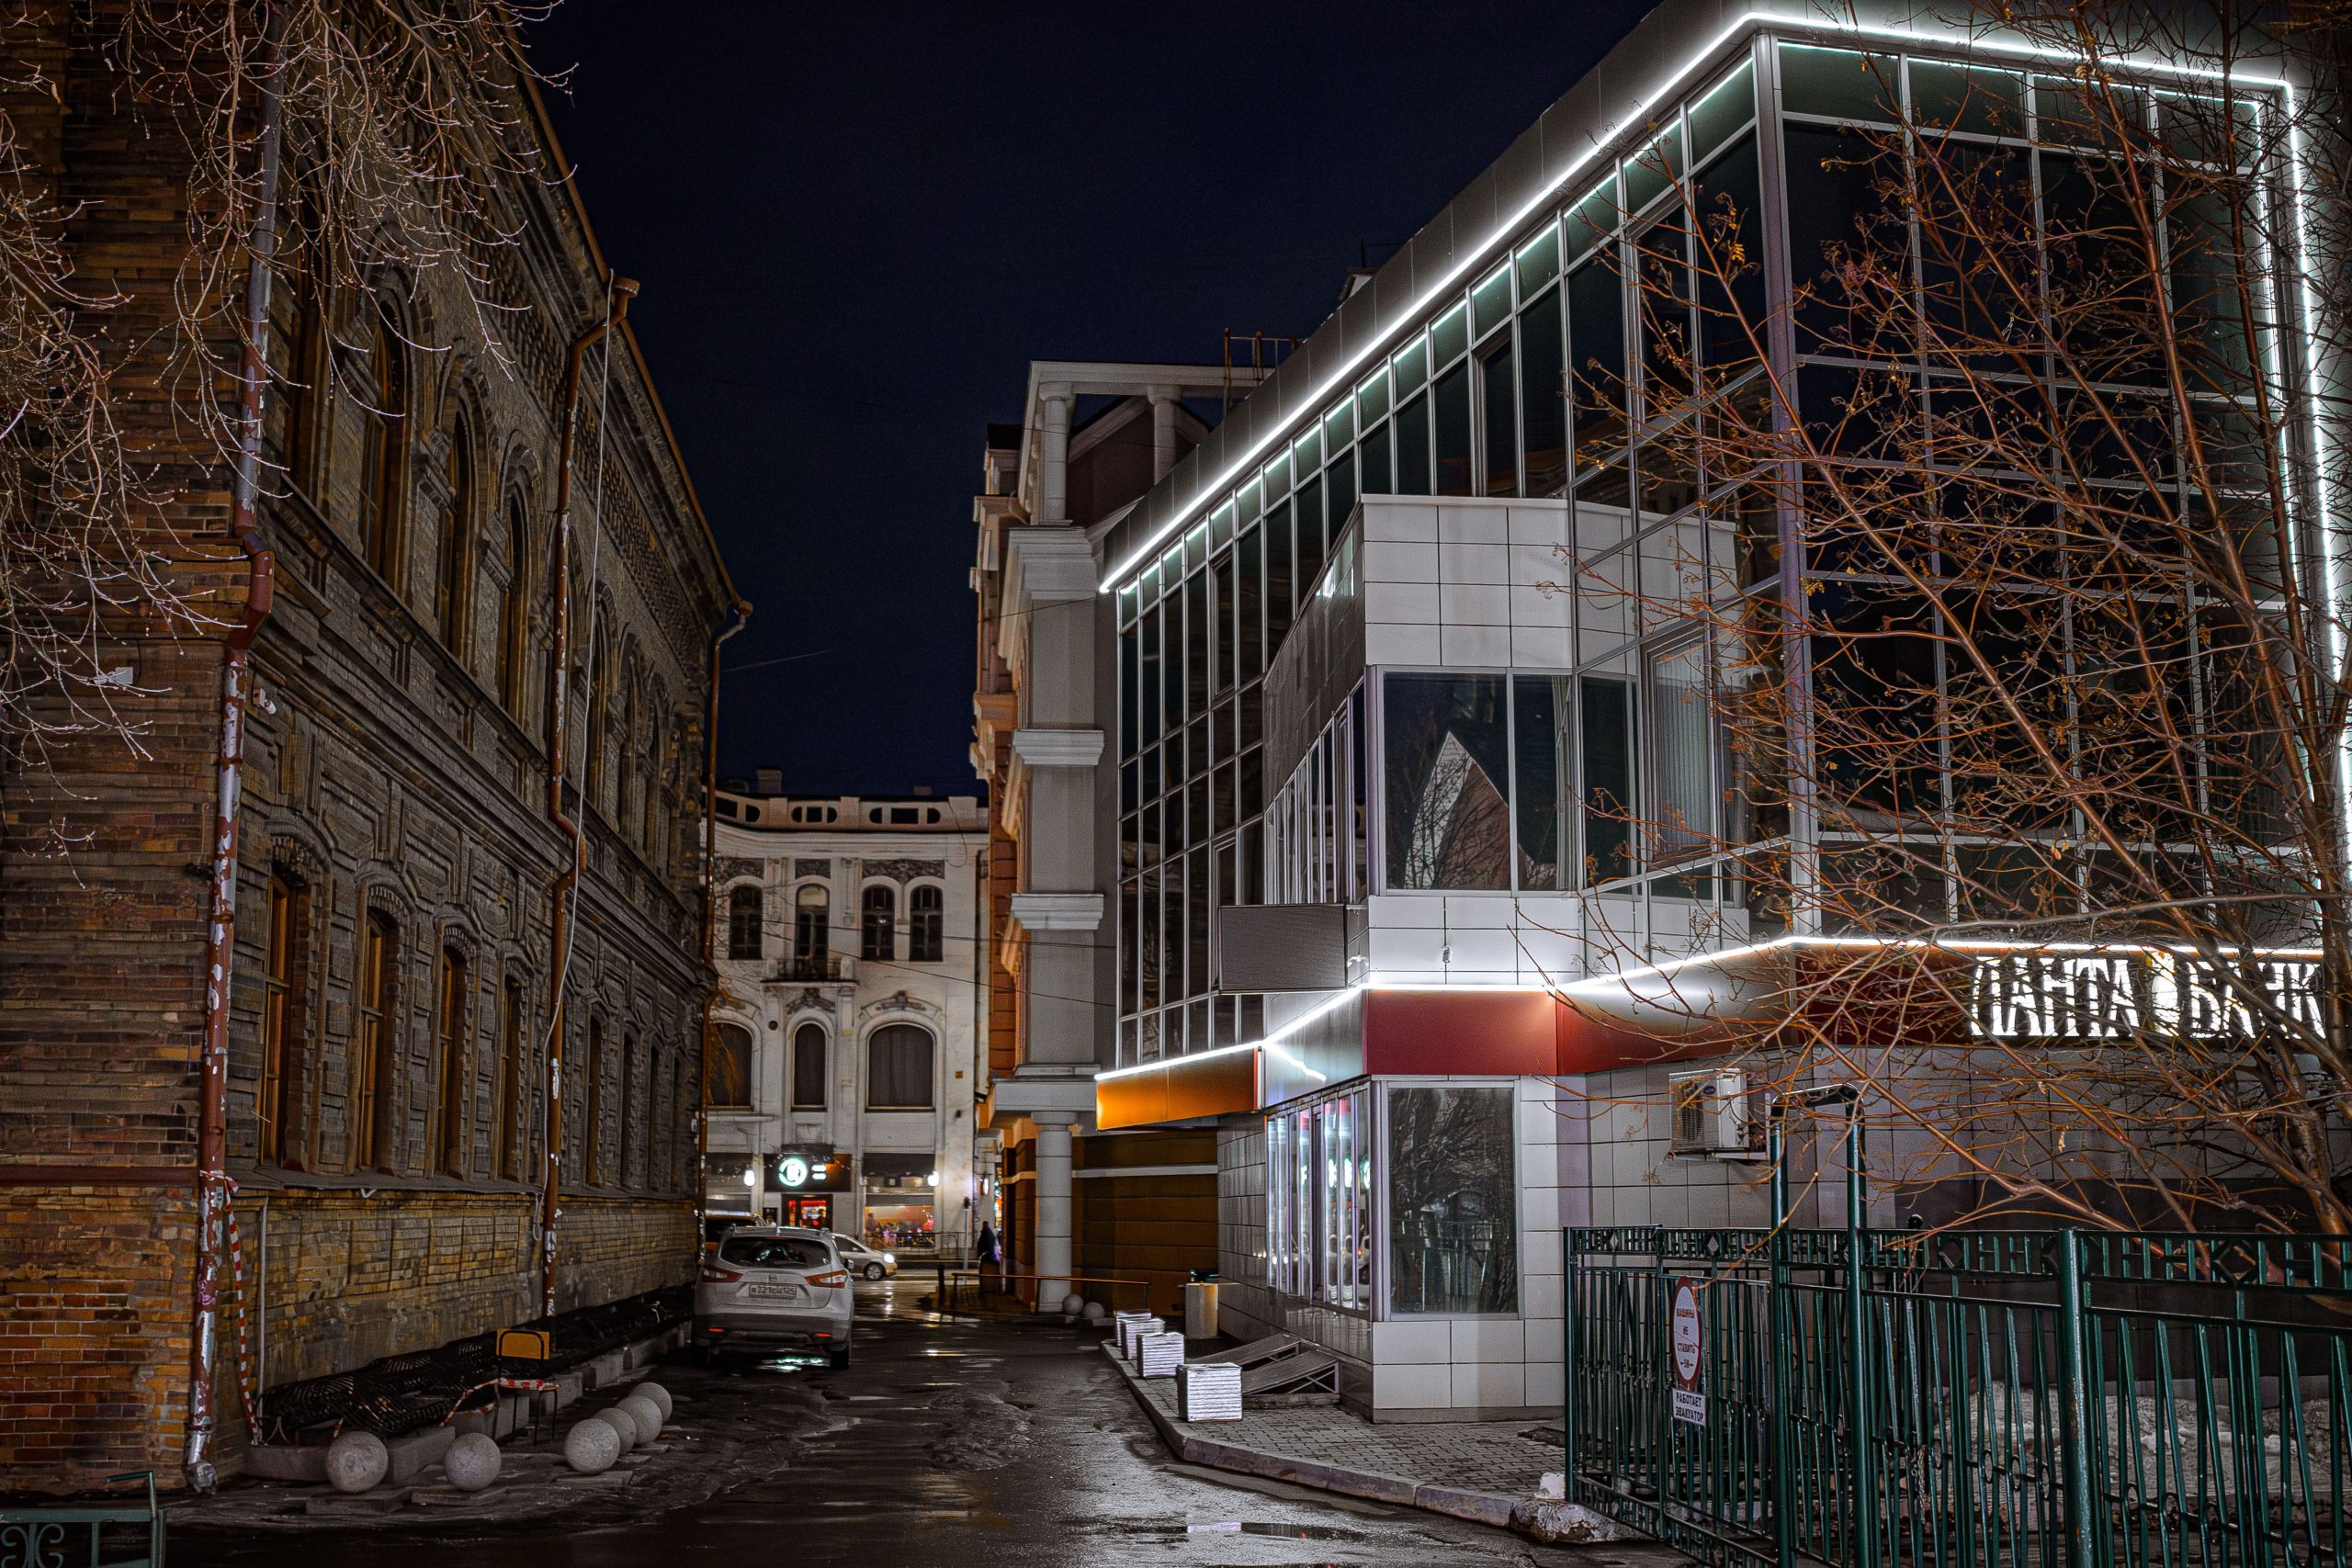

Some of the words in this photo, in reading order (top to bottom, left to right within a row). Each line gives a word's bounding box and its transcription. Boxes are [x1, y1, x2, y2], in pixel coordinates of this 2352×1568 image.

[1677, 1342, 1696, 1355] СТАВИТЬ
[1676, 1392, 1702, 1407] РАБОТАЕТ
[1675, 1405, 1704, 1423] ЭВАКУАТОР
